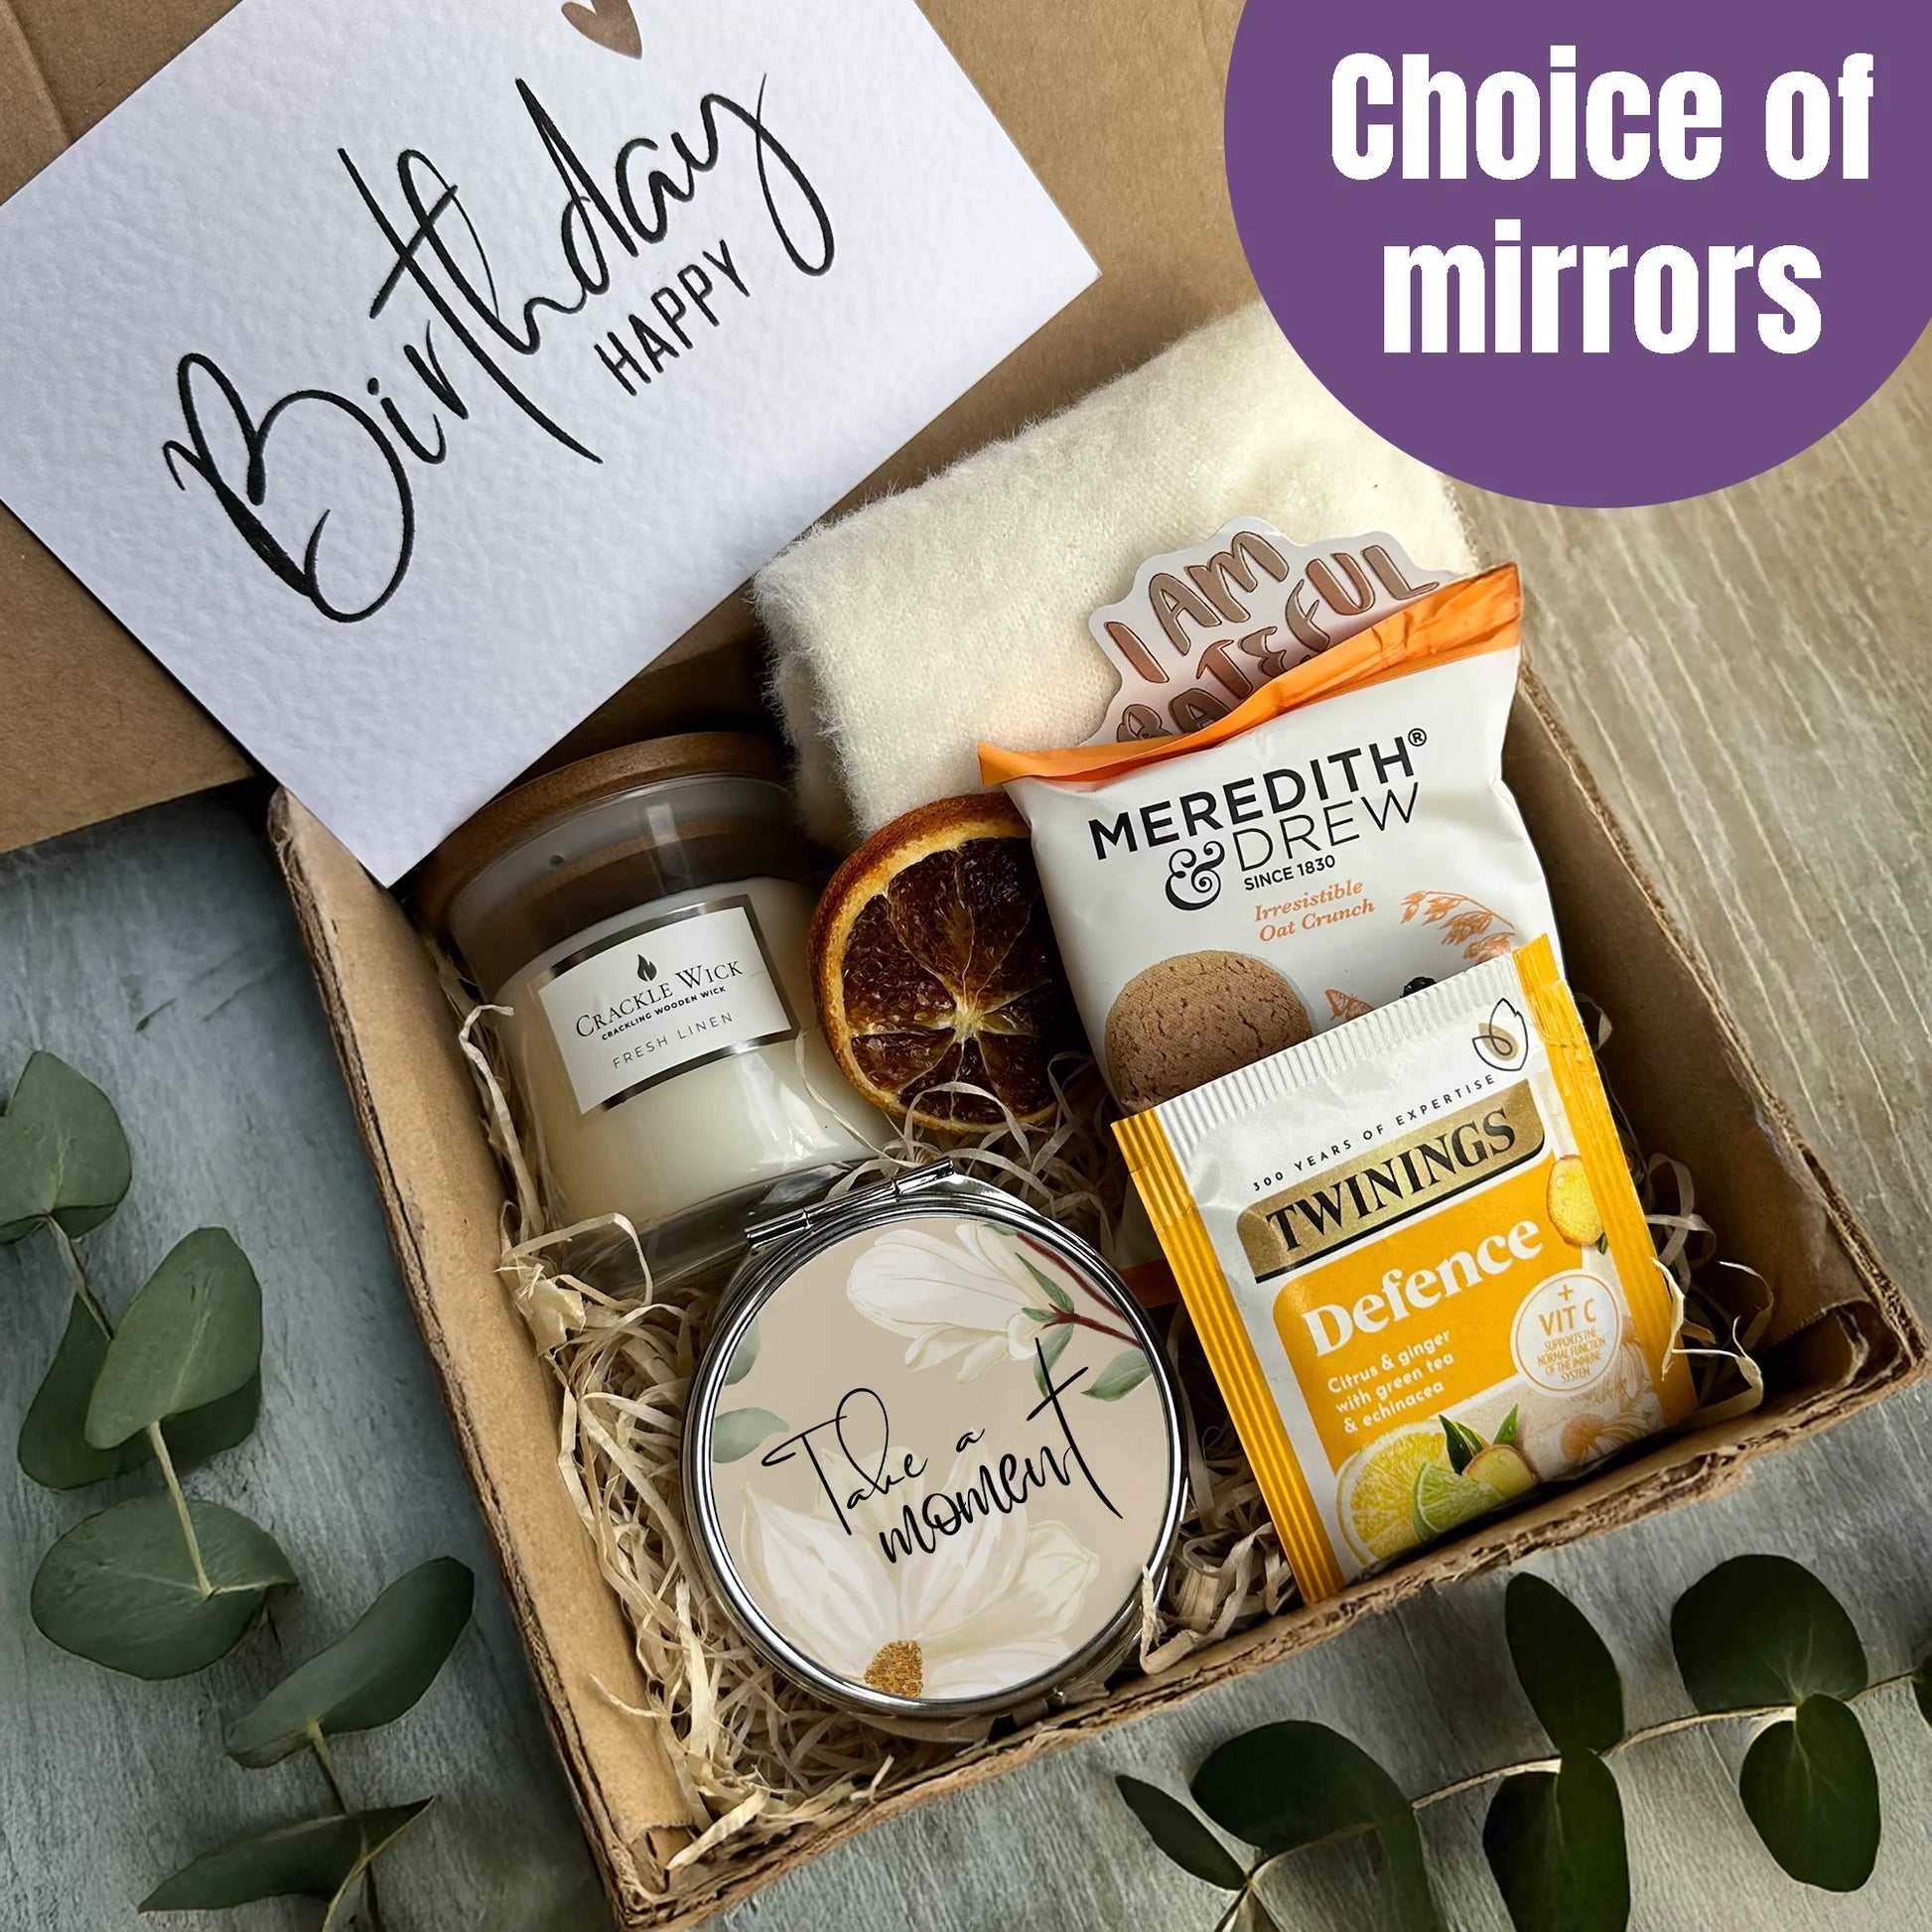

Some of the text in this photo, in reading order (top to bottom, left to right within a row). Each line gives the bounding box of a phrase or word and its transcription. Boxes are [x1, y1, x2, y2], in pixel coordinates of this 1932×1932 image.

[593, 239, 751, 396] HAPPY
[162, 72, 835, 623] Birthday
[1103, 530, 1290, 684] I AM
[1165, 781, 1420, 911] & DREW
[1243, 854, 1336, 892] SINCE 1830
[1254, 878, 1364, 922] Irresistible
[1259, 897, 1375, 942] Oat Crunch
[602, 985, 727, 1040] CRACKLING WOODEN WICK
[613, 1012, 734, 1069] FRESH LINEN
[1252, 1073, 1496, 1192] 300 YEARS OF EXPERTISE
[1265, 1108, 1517, 1252] TWININGS
[1301, 1220, 1544, 1357] Defence
[1538, 1299, 1595, 1335] VIT C
[1327, 1329, 1450, 1394] Citrus & ginger
[1537, 1335, 1605, 1366] NORMAL FUNCTION
[1544, 1331, 1583, 1350] SUPPORTS
[1546, 1351, 1601, 1375] OF THE IMMUNE
[1334, 1352, 1455, 1414] with green tea
[1560, 1367, 1589, 1382] SYSTEM
[1343, 1380, 1446, 1434] & echinacea
[760, 1387, 986, 1537] Take a
[878, 1337, 1125, 1565] moment
